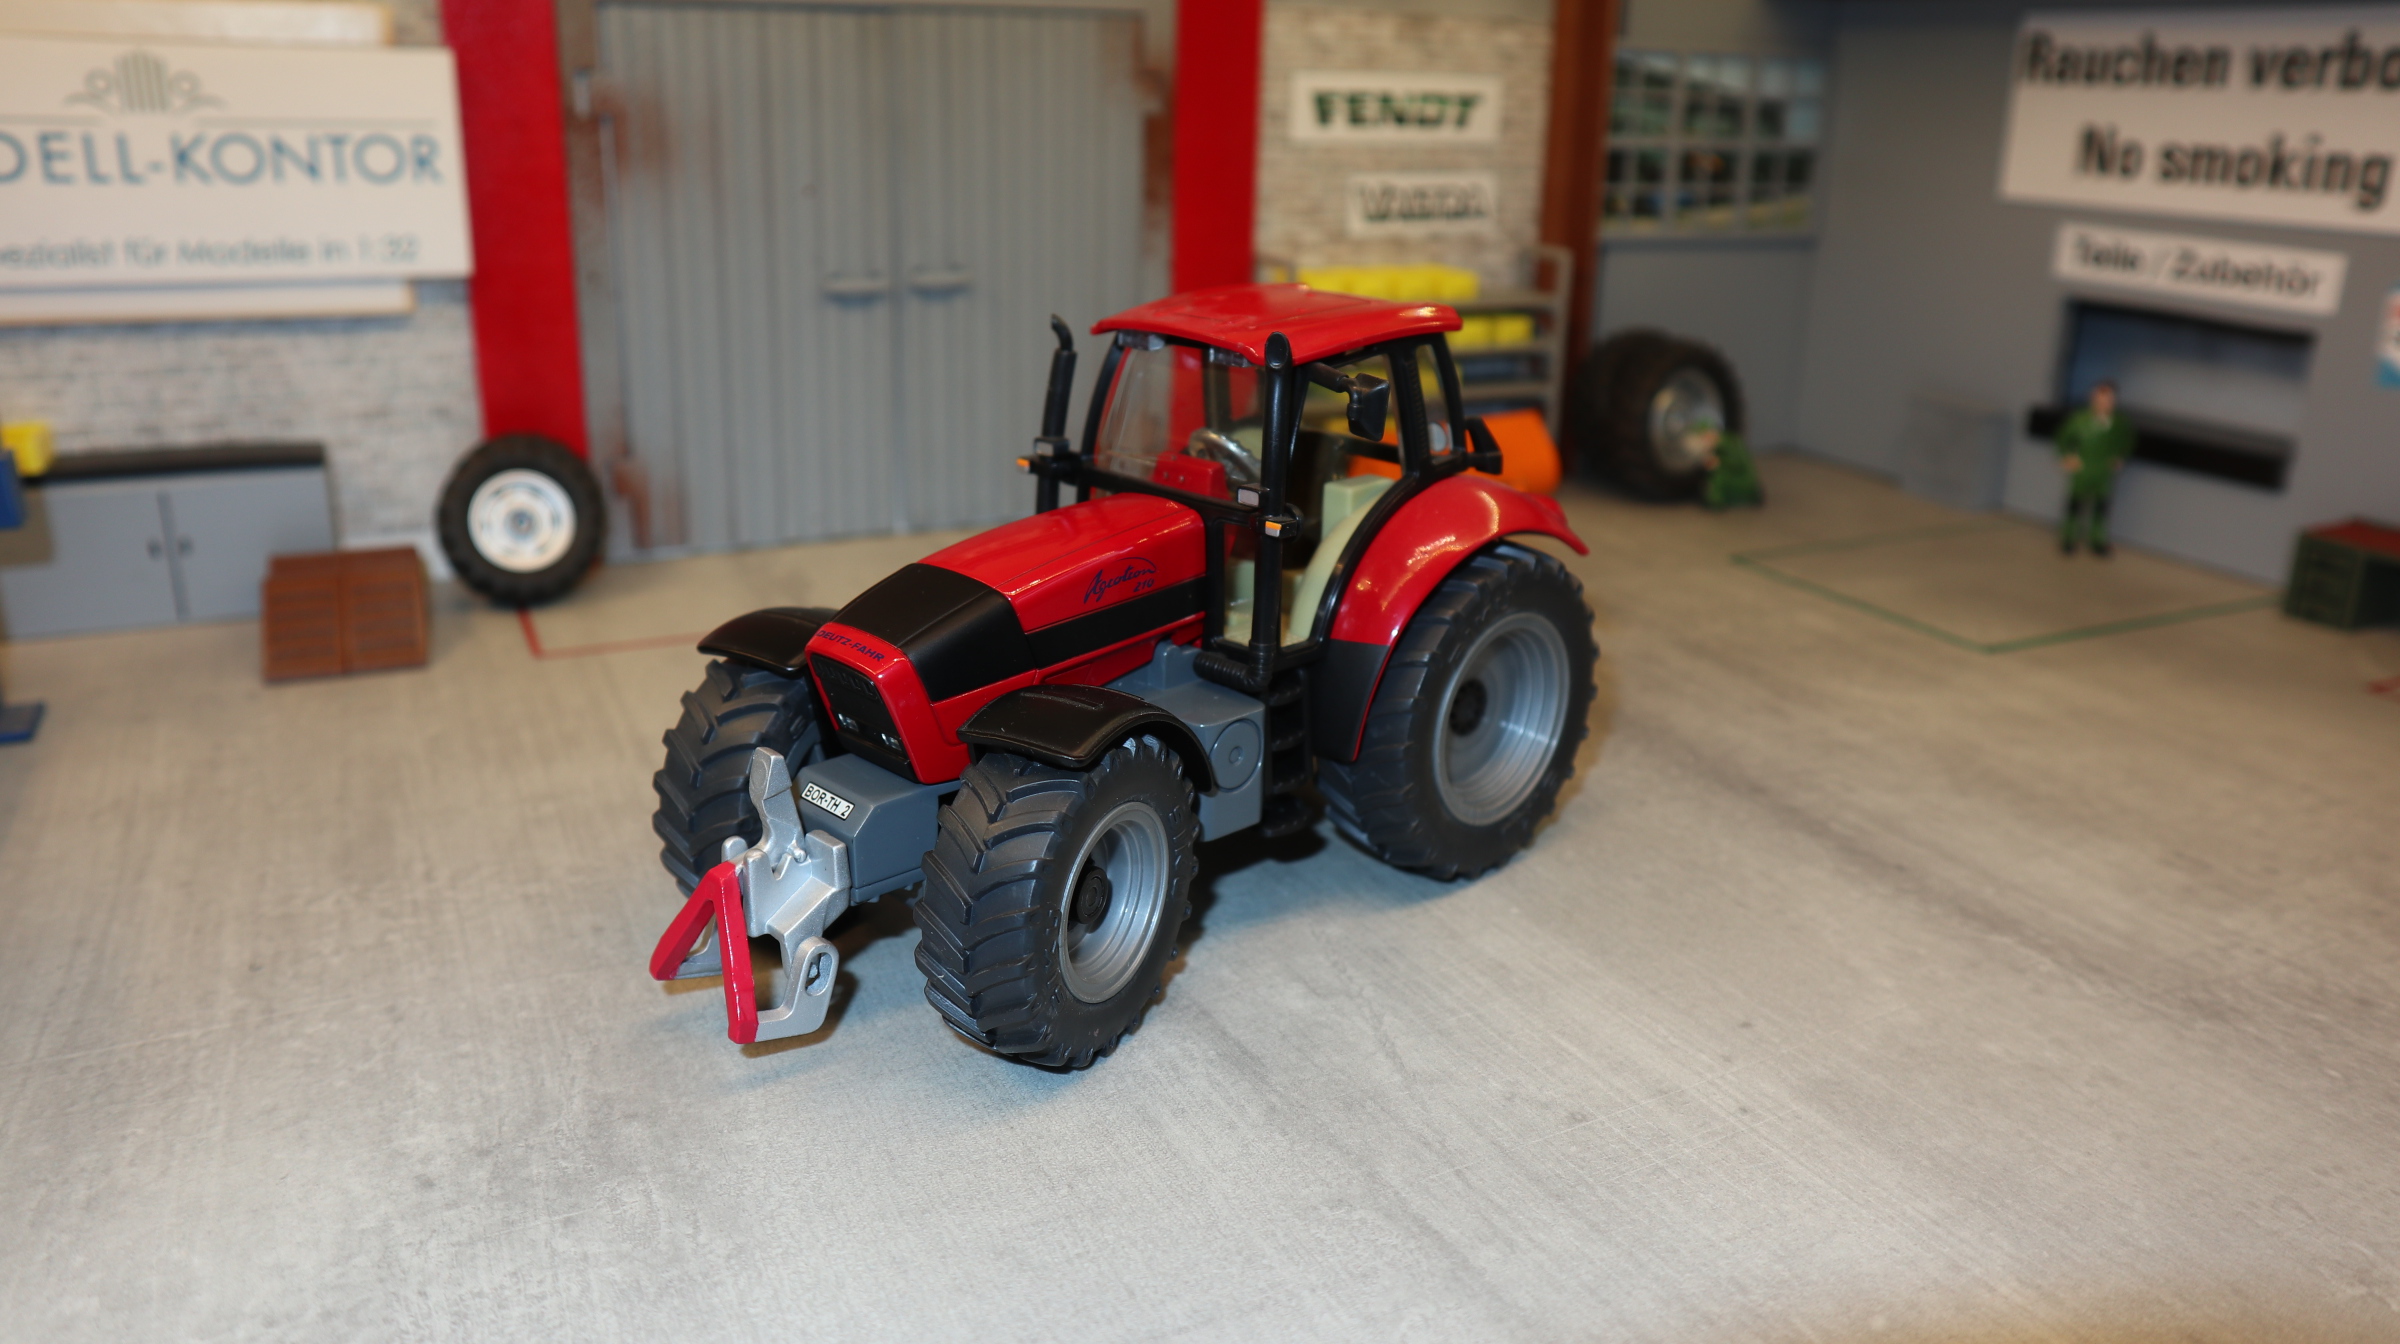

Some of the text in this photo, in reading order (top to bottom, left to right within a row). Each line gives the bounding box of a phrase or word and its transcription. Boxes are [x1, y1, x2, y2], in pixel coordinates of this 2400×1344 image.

[2023, 30, 2232, 87] Rauchen
[1313, 93, 1482, 128] FENDT
[2076, 125, 2393, 212] No smoking
[1132, 578, 1155, 593] 210
[816, 630, 885, 662] DEUTZ-FAHR
[804, 785, 851, 817] BOR-TH 2
